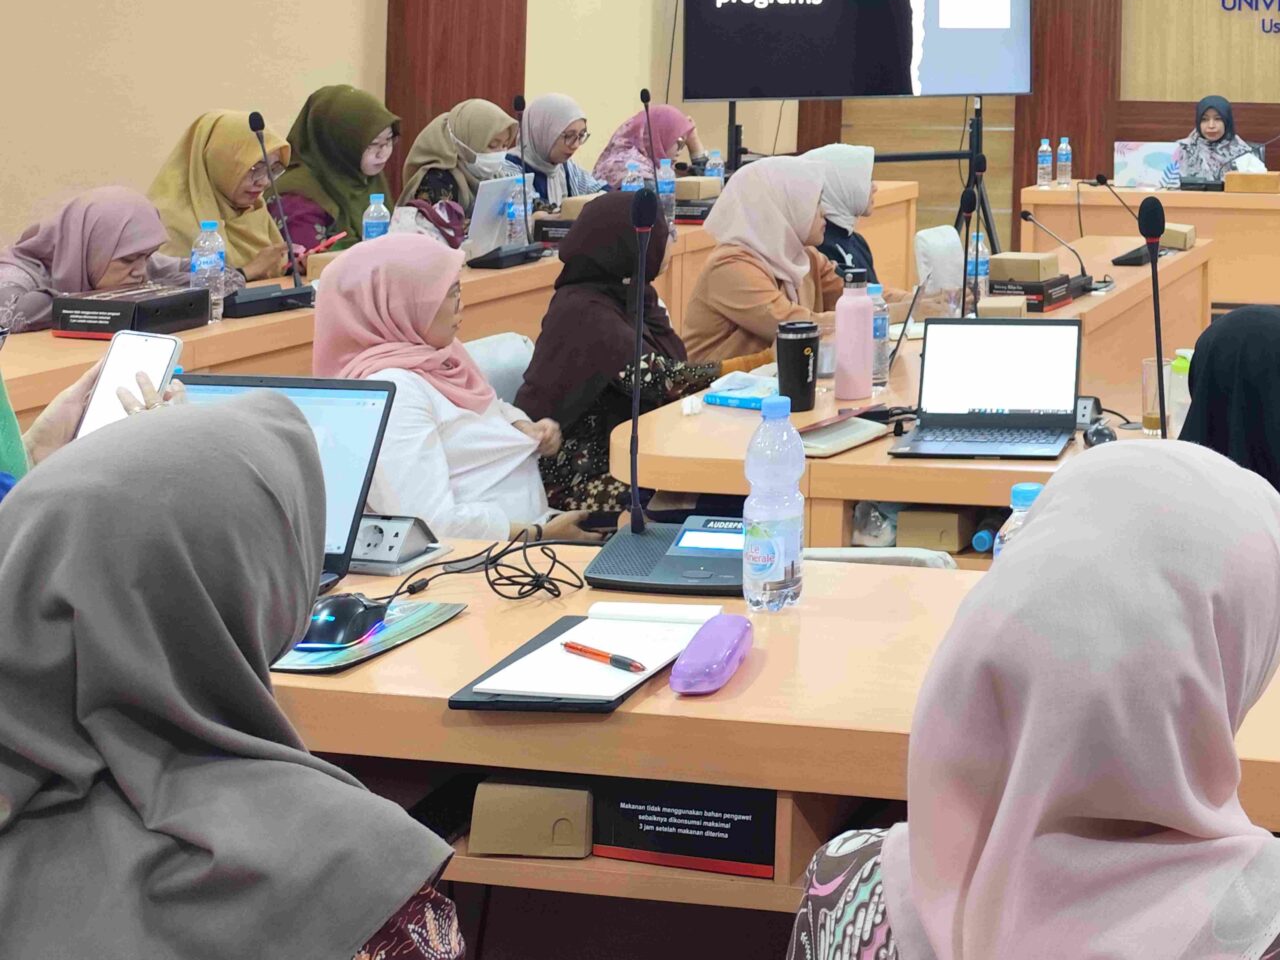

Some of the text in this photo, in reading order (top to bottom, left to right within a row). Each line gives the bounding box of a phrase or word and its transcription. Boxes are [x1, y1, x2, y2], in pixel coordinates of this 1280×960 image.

[620, 802, 646, 811] Makanan
[646, 804, 661, 812] tidak
[704, 810, 722, 818] bahan
[643, 823, 654, 831] jam
